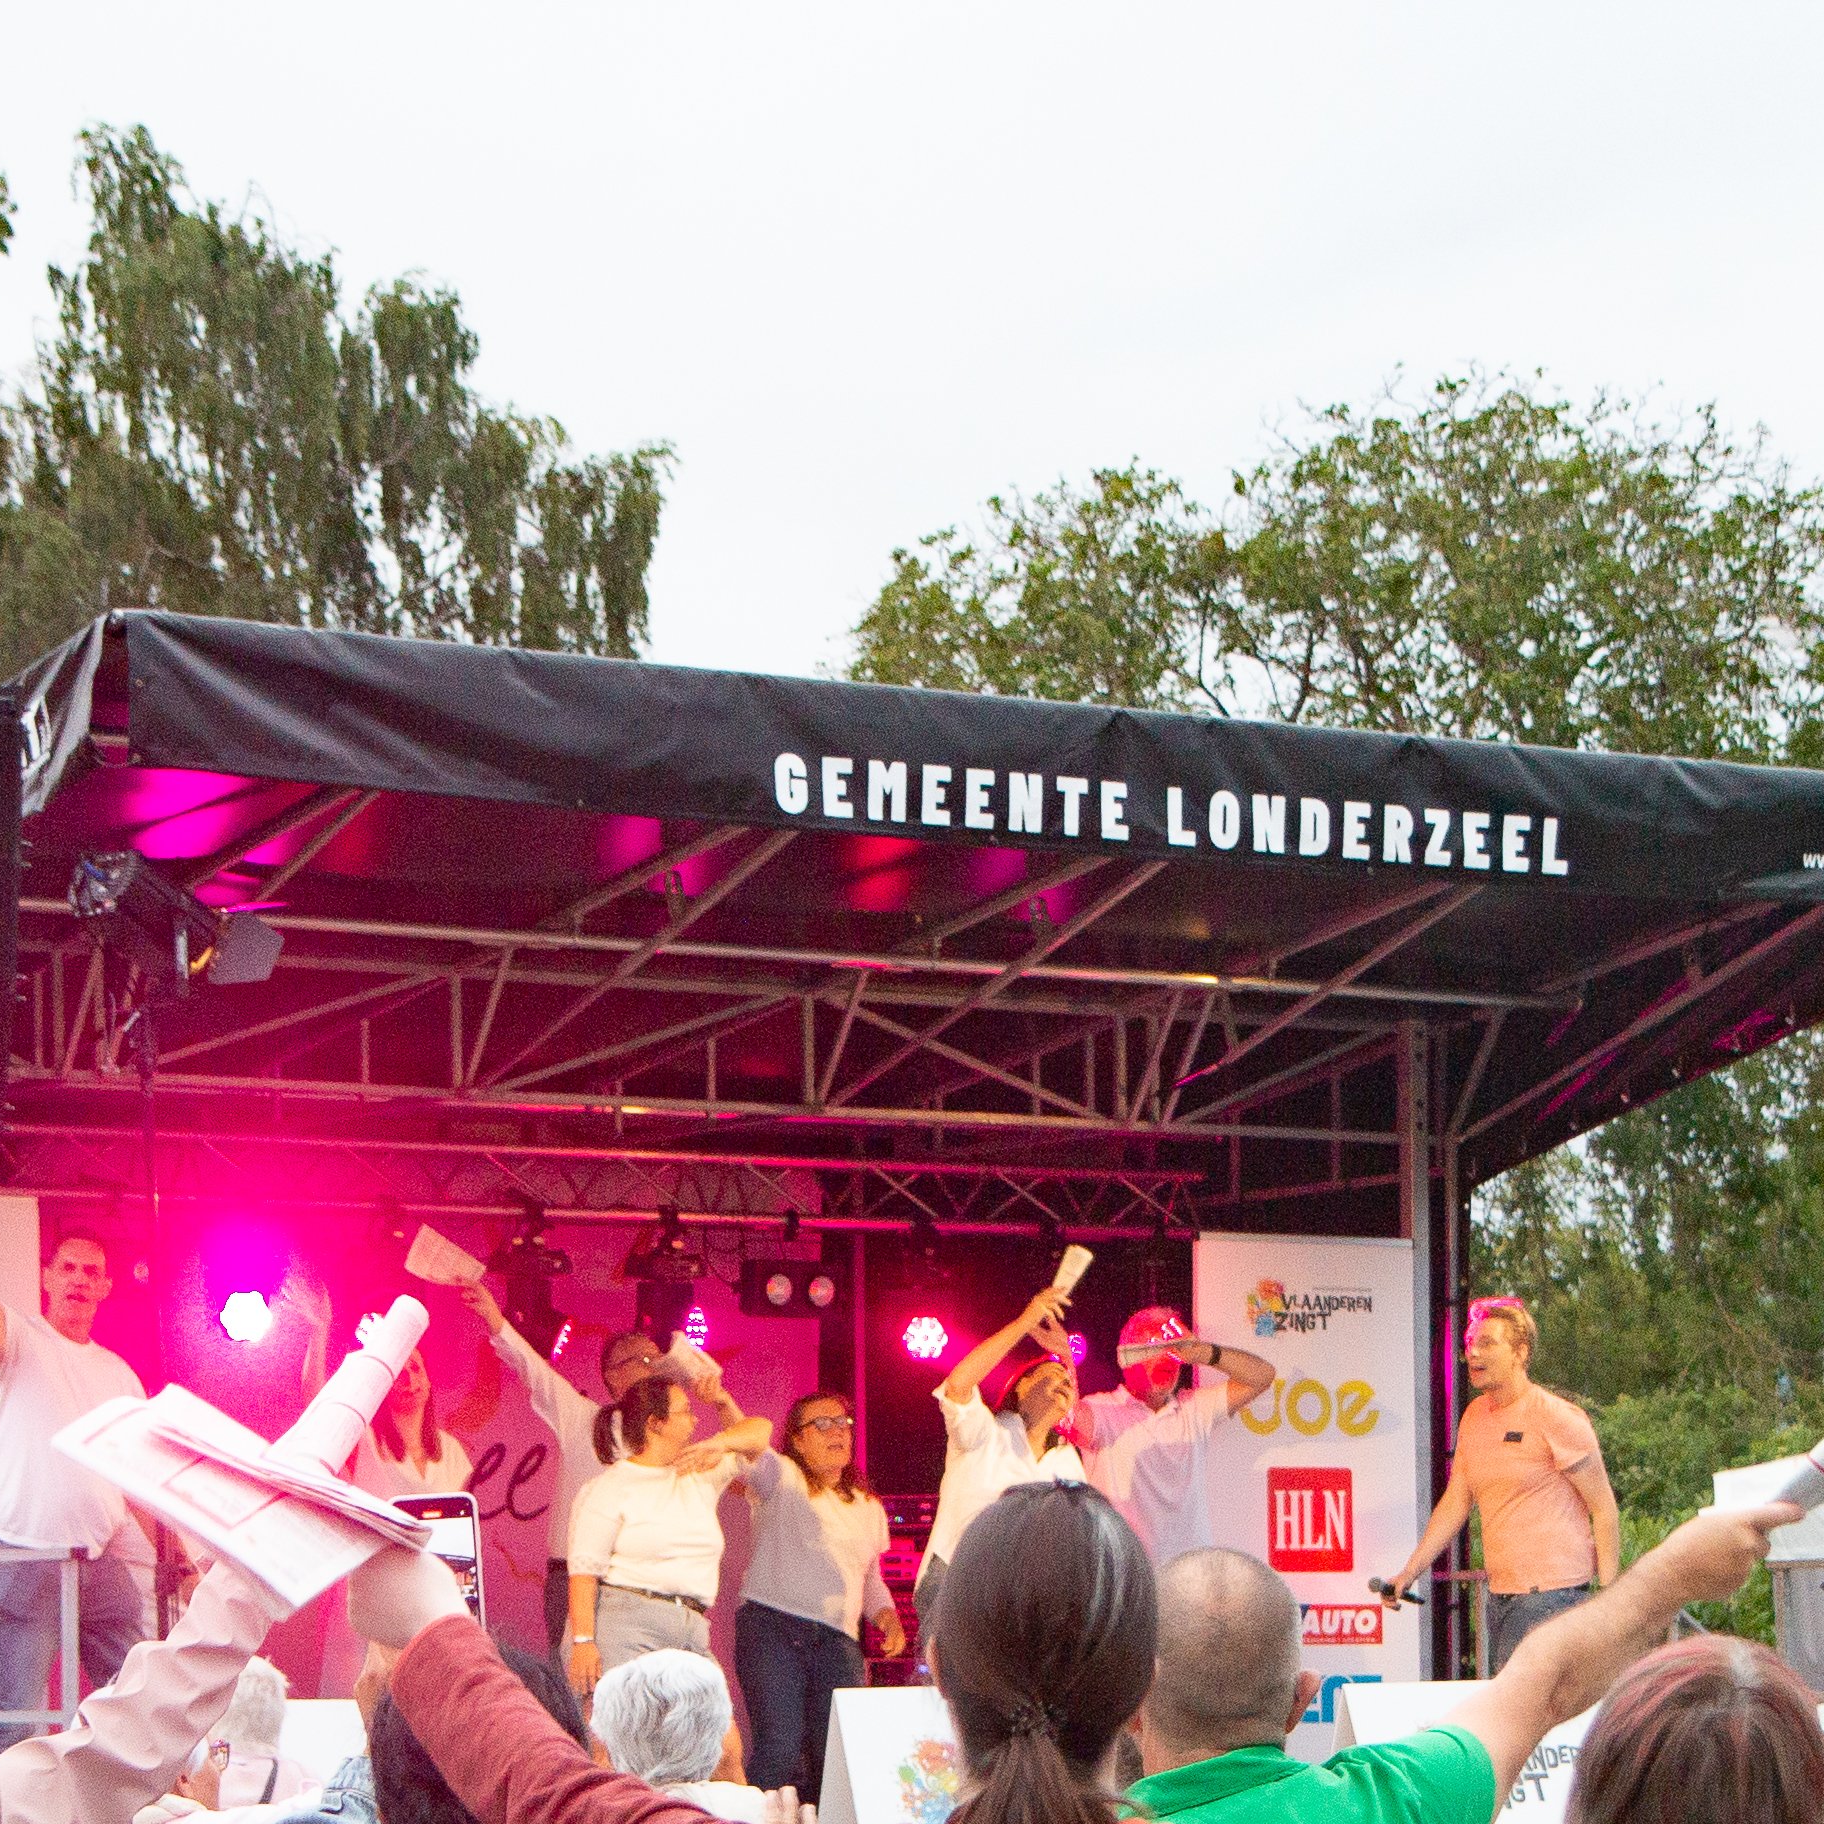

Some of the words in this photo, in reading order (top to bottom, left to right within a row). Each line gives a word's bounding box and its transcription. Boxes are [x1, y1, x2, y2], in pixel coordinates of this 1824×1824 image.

[773, 752, 1130, 842] GEMEENTE
[1165, 786, 1569, 876] LONDERZEEL
[1280, 1293, 1372, 1313] VLAANDEREN
[1274, 1311, 1331, 1334] ZINGT
[1273, 1489, 1347, 1550] HLN
[1301, 1609, 1378, 1635] AUTO
